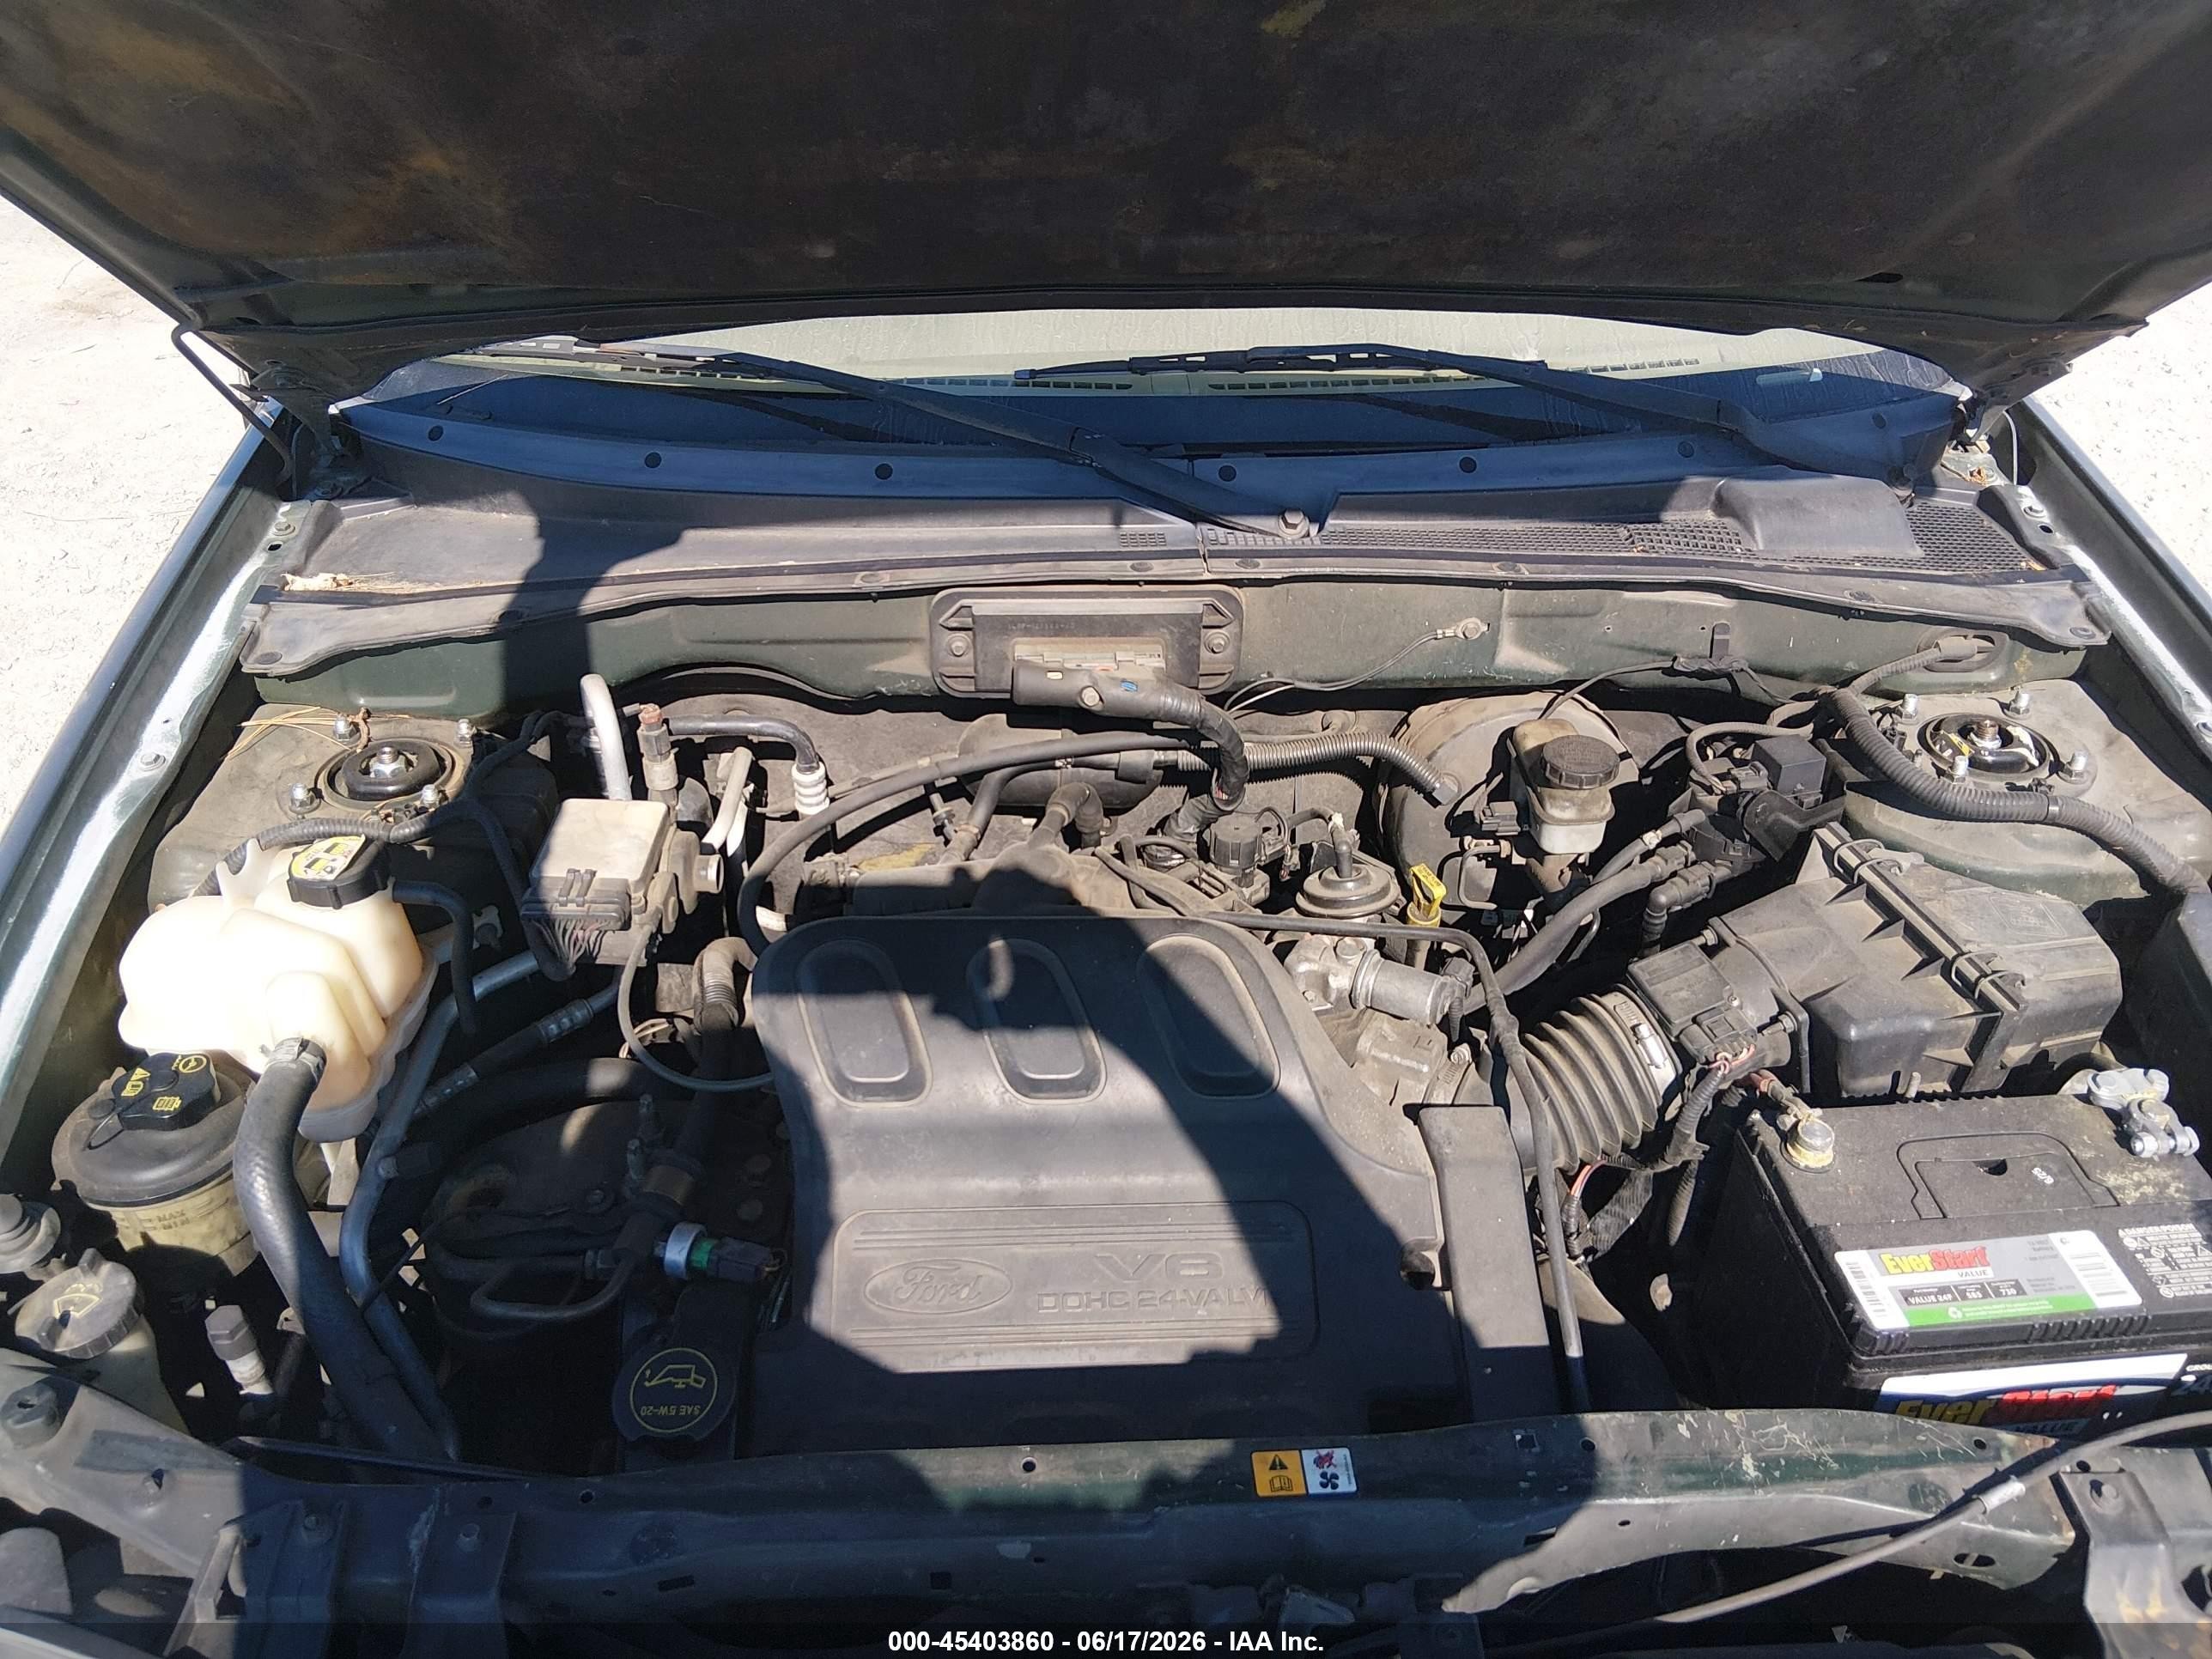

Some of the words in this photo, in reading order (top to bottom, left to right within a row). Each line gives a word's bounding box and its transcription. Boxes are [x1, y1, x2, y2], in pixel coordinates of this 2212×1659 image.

[156, 1209, 185, 1223] MAX
[162, 1217, 191, 1231] MIN
[1094, 1251, 1224, 1281] V6
[1881, 1246, 1990, 1274] EverStart
[1957, 1269, 1989, 1278] VALUE
[895, 1266, 983, 1305] Ford
[1036, 1290, 1130, 1313] DOHC
[1138, 1287, 1269, 1309] 24-VALV
[1908, 1295, 1938, 1305] VALUE
[640, 1405, 677, 1416] 5W-20
[679, 1405, 701, 1416] SAE
